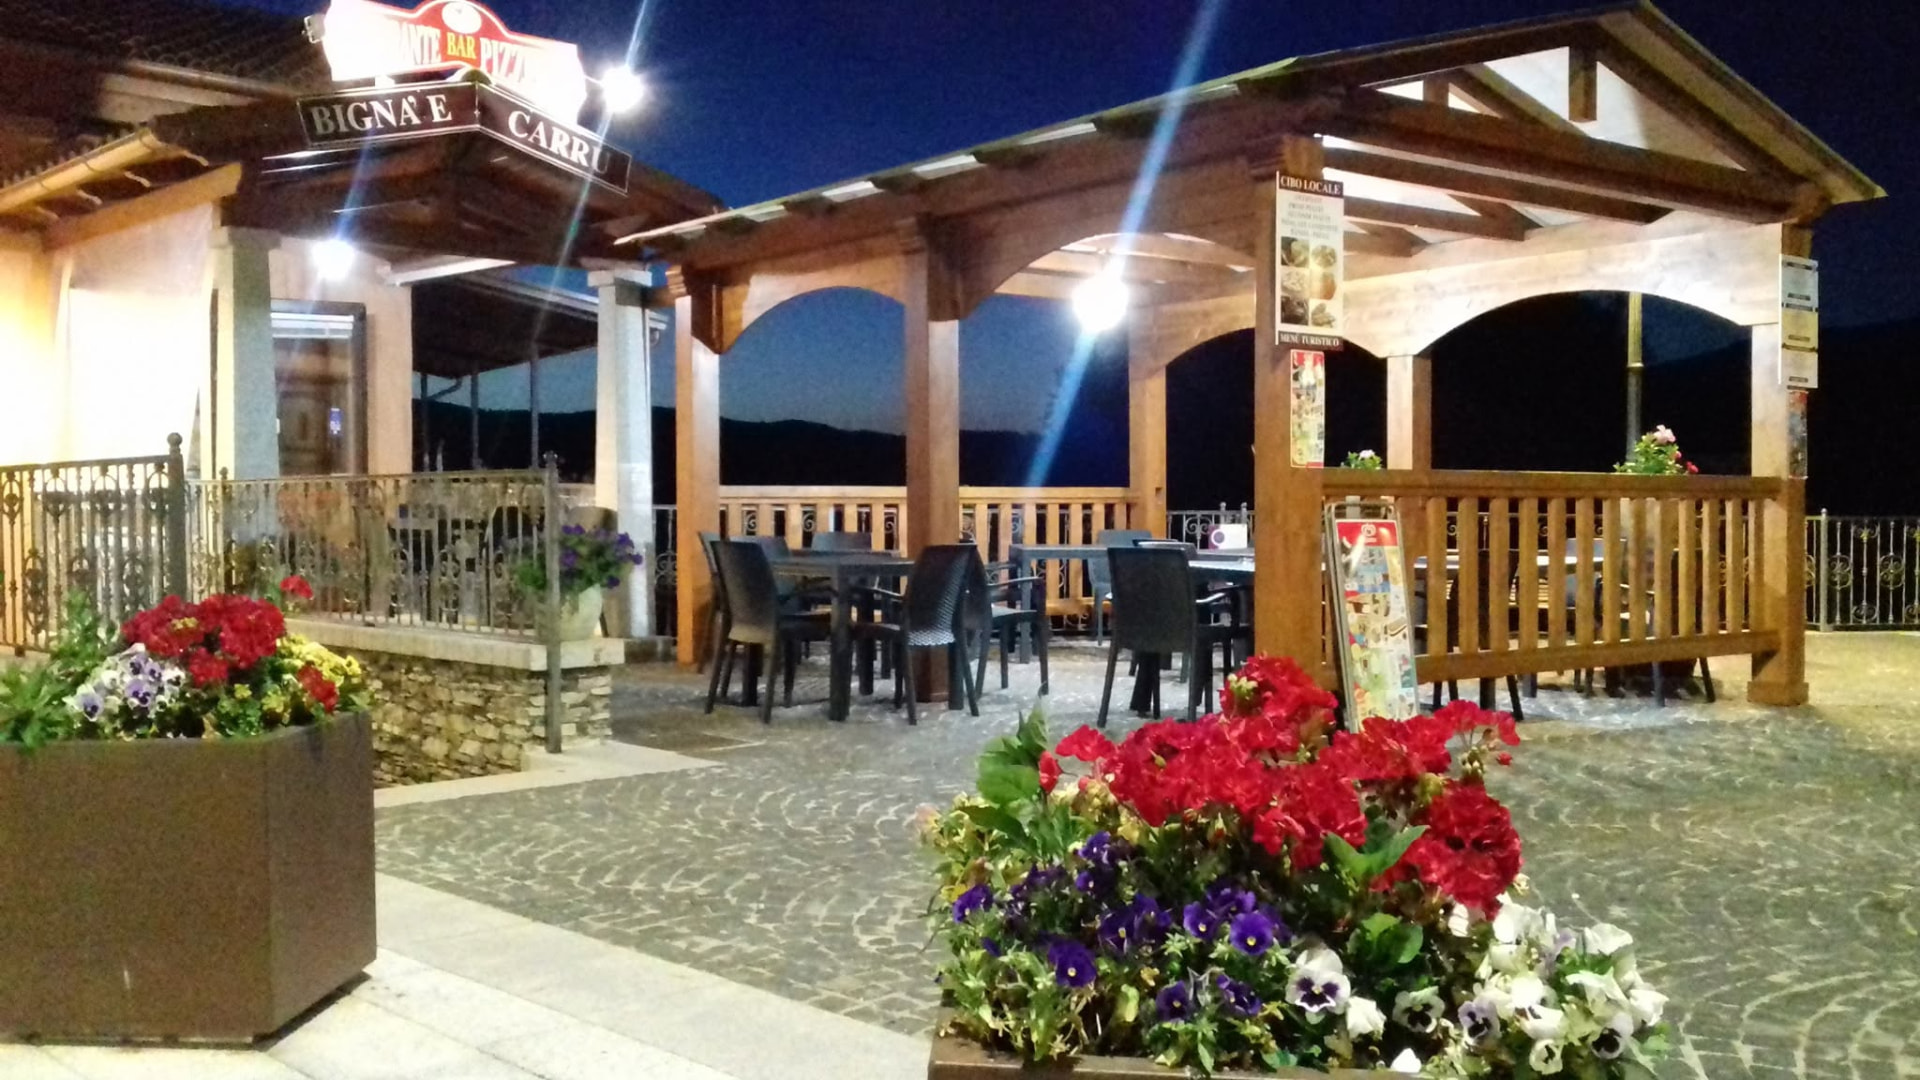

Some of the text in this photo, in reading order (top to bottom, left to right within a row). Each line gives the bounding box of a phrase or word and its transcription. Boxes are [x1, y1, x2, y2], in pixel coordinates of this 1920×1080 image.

[446, 32, 477, 60] BAR
[426, 94, 453, 123] E
[1280, 175, 1341, 195] CIBO LOCALE
[1301, 334, 1340, 347] TURISTICO
